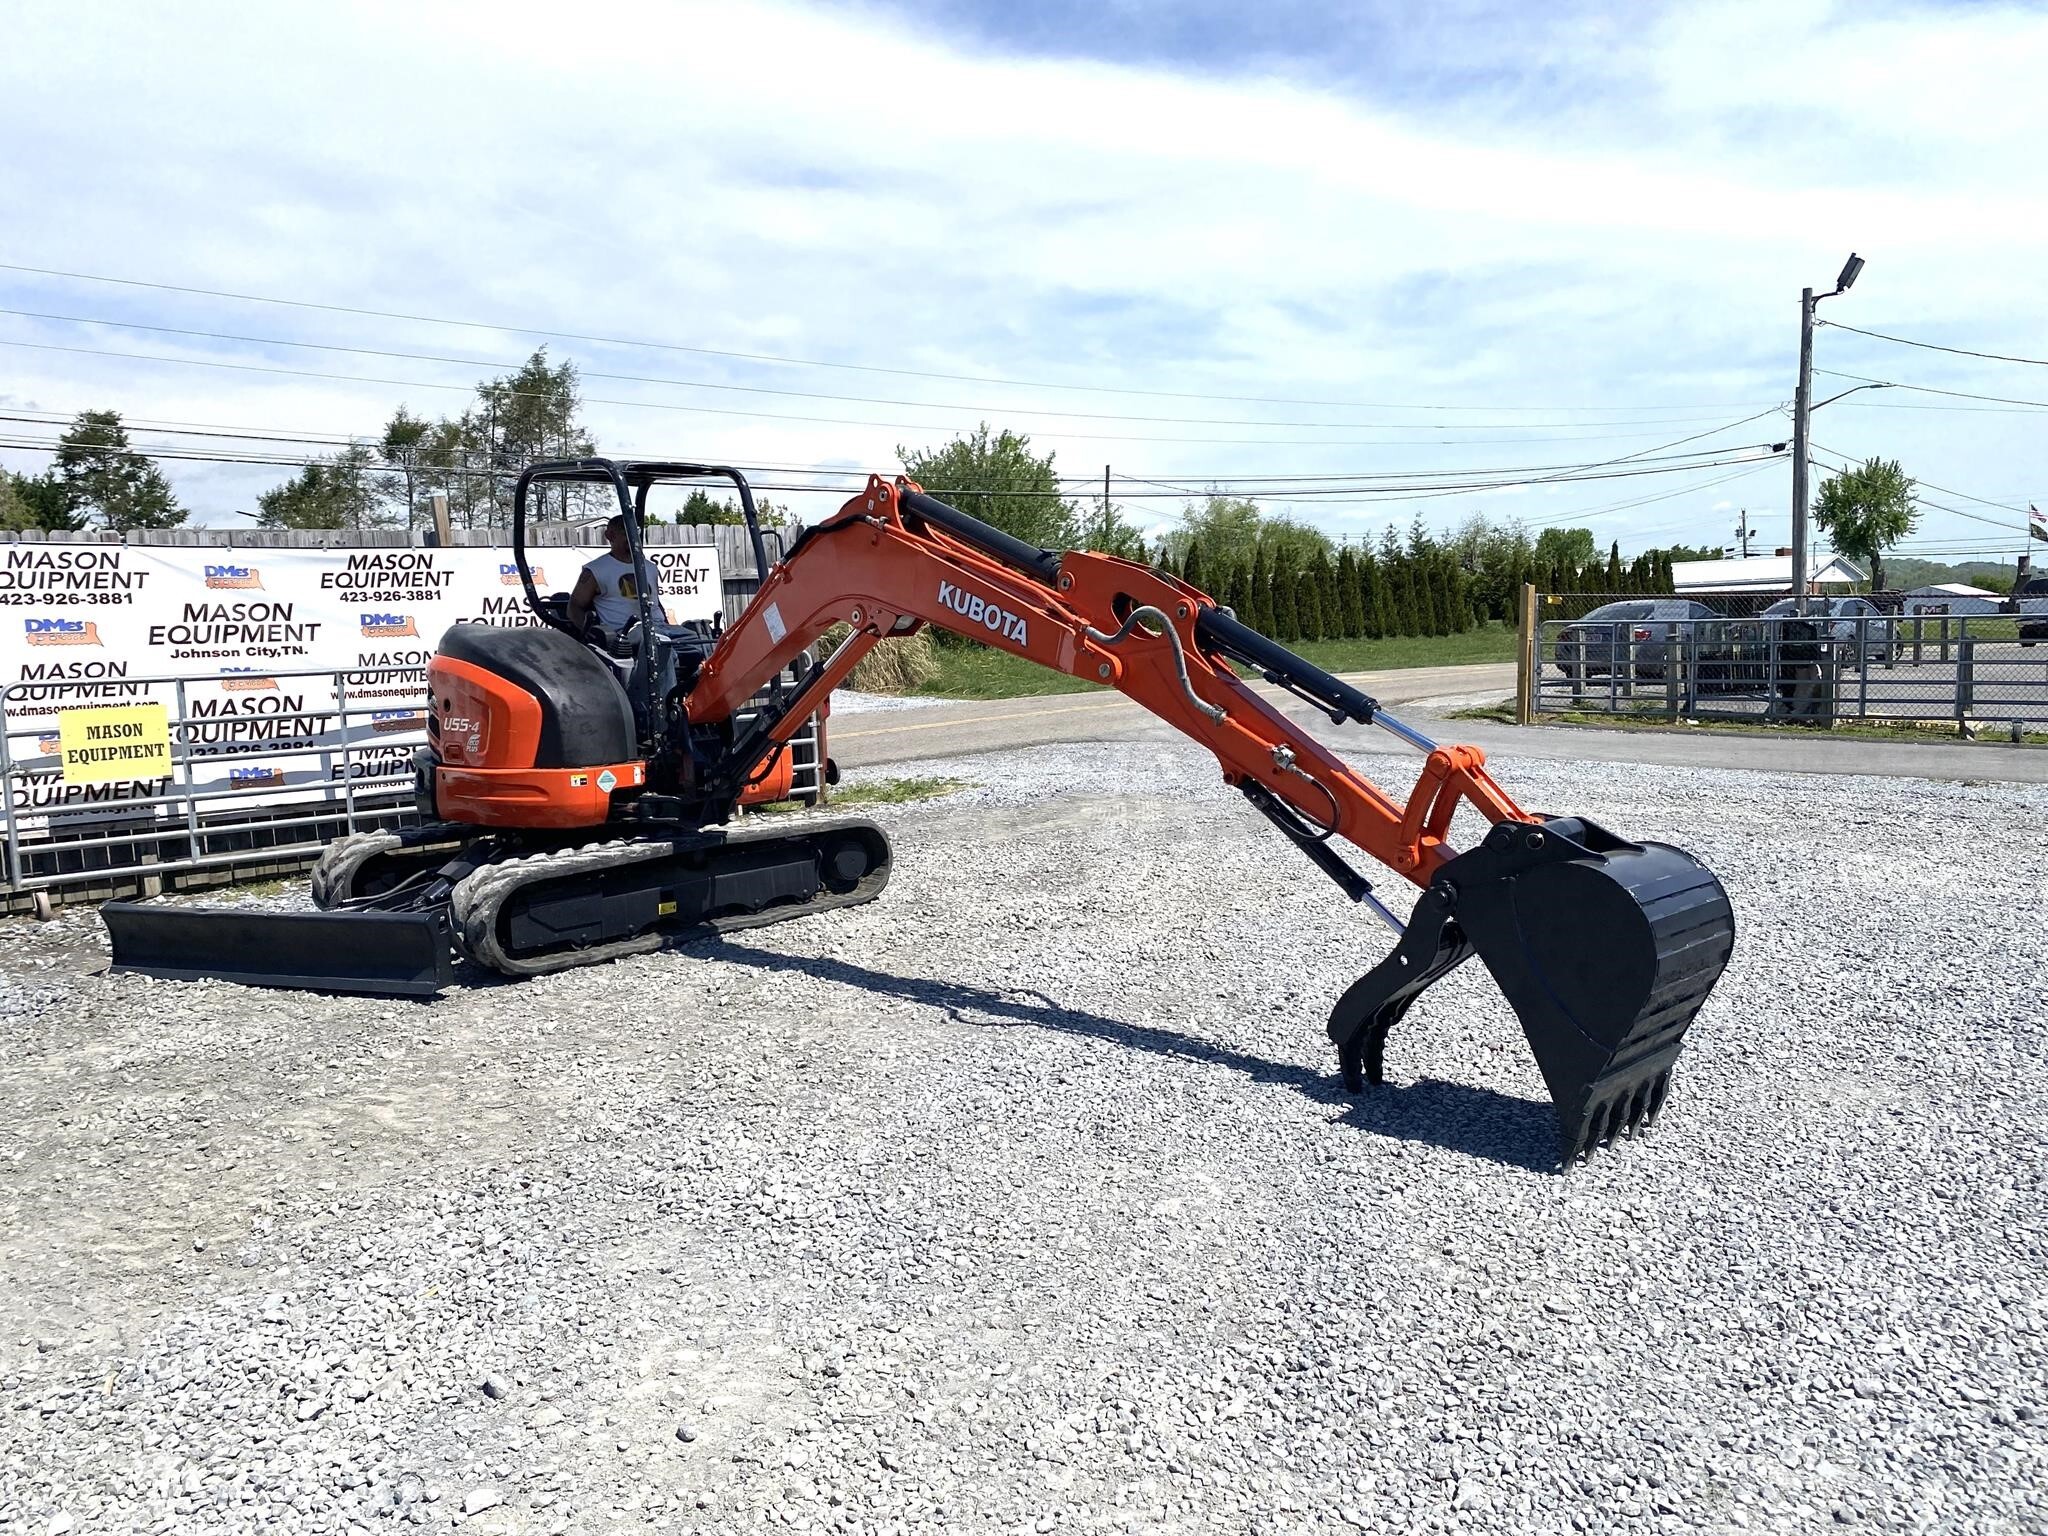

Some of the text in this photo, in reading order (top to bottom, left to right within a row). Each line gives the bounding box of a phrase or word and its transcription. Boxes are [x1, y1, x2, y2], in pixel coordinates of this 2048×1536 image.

[7, 551, 120, 569] MASON
[347, 554, 433, 570] MASON
[321, 571, 454, 589] EQUIPMENT
[657, 569, 709, 583] MENT
[0, 593, 133, 605] 423-926-3881
[340, 590, 442, 603] 423-926-3881
[482, 596, 551, 615] MAS
[183, 603, 293, 622] MASON
[937, 580, 1029, 647] KUBOTA
[149, 623, 321, 645] EQUIPMENT
[170, 647, 309, 659] Johnson City,TN.
[20, 661, 127, 681] MASON
[0, 683, 150, 701] QUIPMENT
[331, 685, 428, 700] ww.dmasonequipm
[191, 695, 303, 717] MASON
[86, 722, 143, 740] MASON
[67, 743, 165, 765] EQUIPMENT
[0, 778, 173, 808] QUIPMENT
